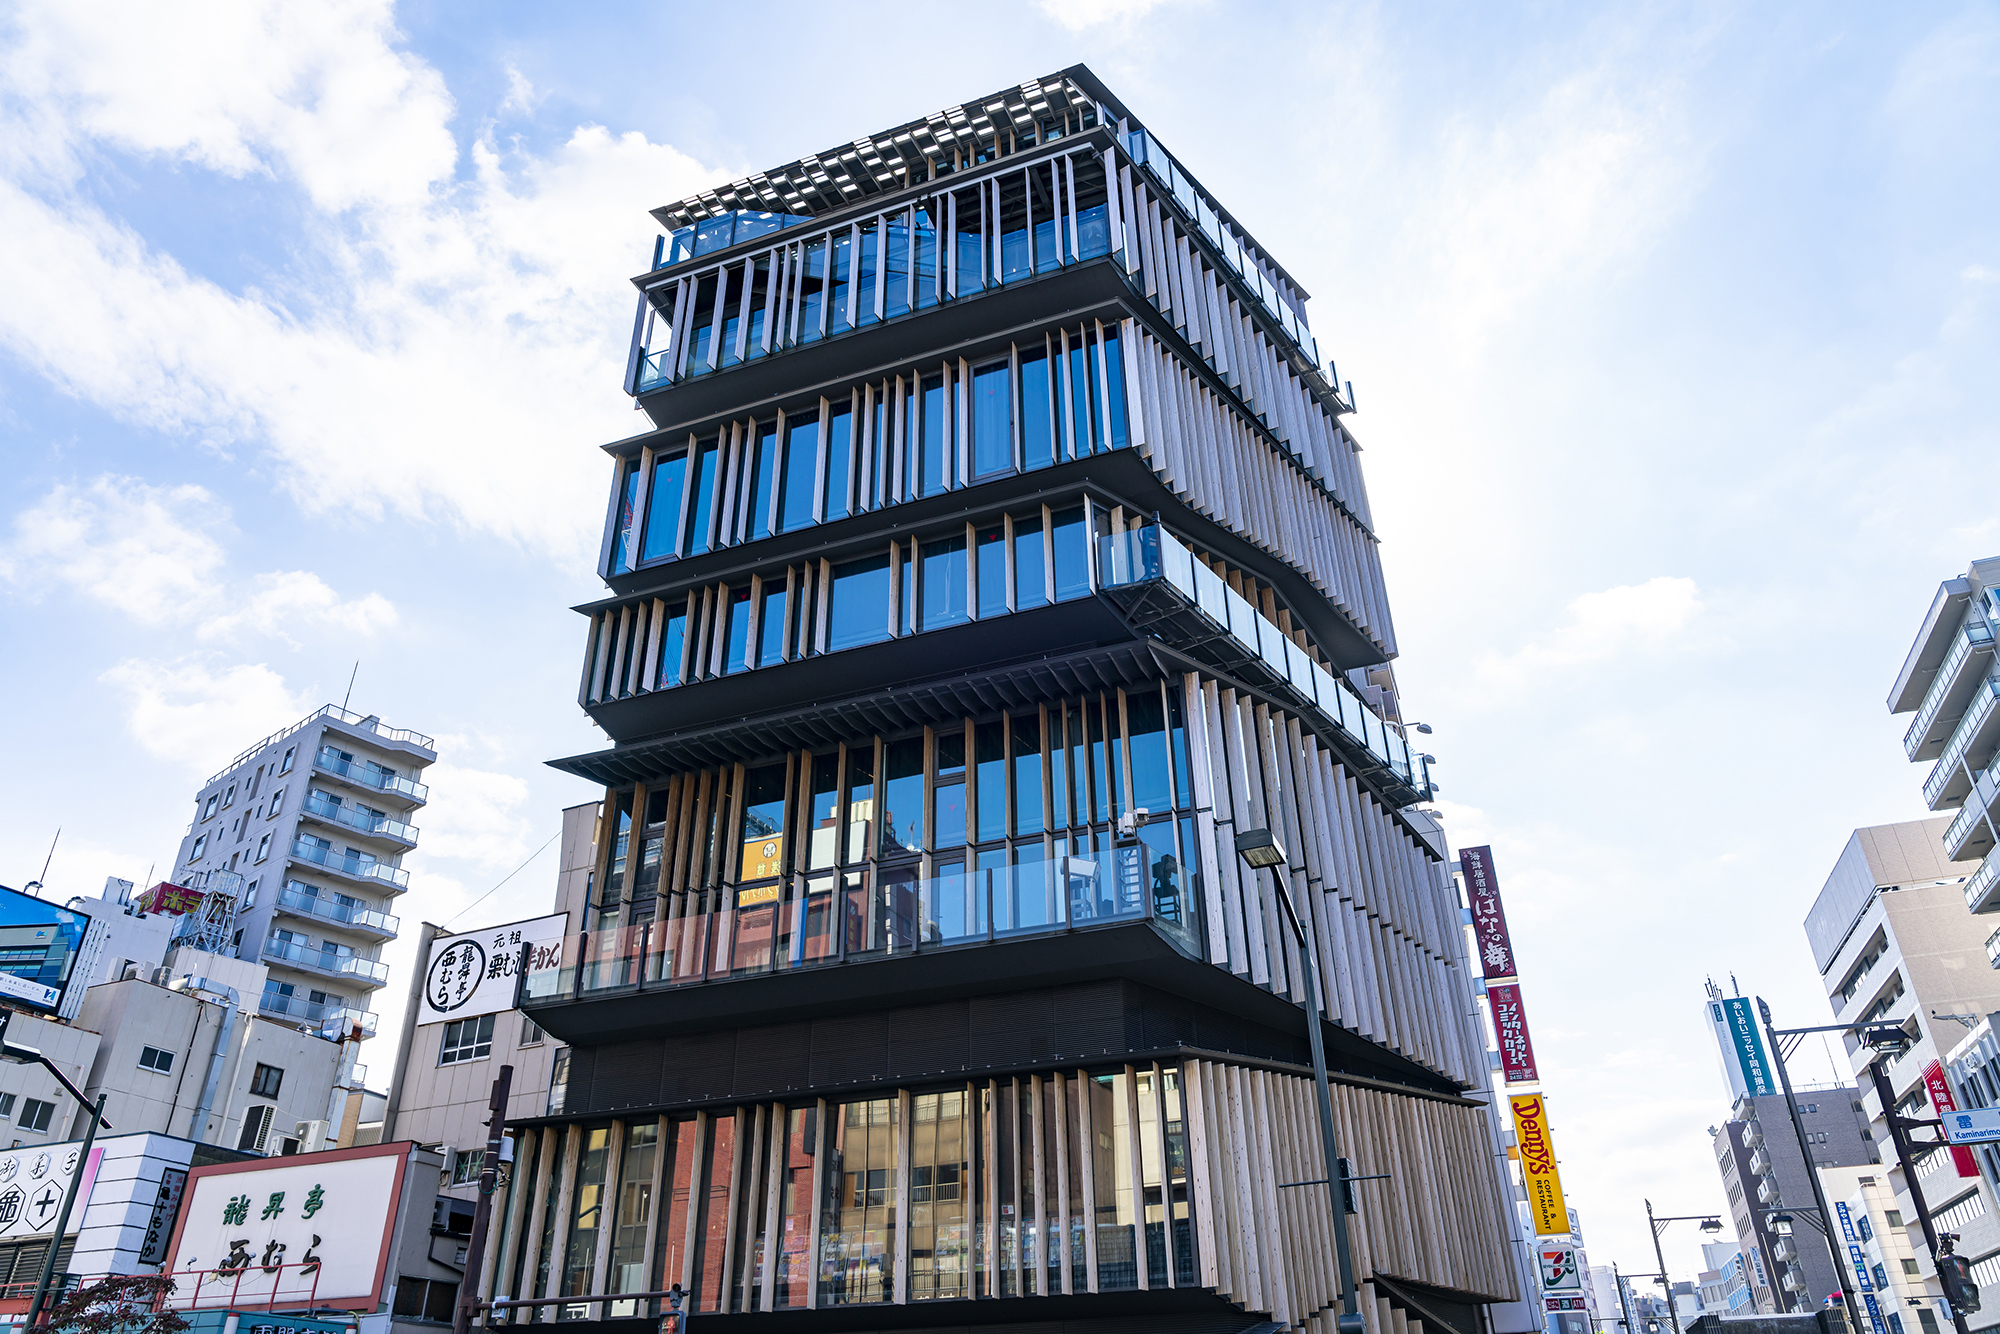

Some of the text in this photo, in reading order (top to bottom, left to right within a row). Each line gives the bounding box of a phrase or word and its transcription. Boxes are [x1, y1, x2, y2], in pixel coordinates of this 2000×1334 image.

[1470, 851, 1489, 897] 海鮮居酒屋
[493, 930, 522, 949] 元祖
[1475, 898, 1509, 973] はなの舞
[437, 950, 457, 1006] 西むら
[455, 945, 476, 1001] 龍昇亭
[1497, 1003, 1519, 1065] コミックカフェ
[1732, 1001, 1767, 1094] あいおいニッセイ同和損保
[1512, 1098, 1555, 1175] Denny's
[222, 1183, 326, 1226] 龍昇亭
[1535, 1179, 1552, 1230] RESTAURANT
[1543, 1179, 1556, 1209] COFFEE
[218, 1233, 323, 1277] 西むら
[1573, 1298, 1585, 1308] ATM
